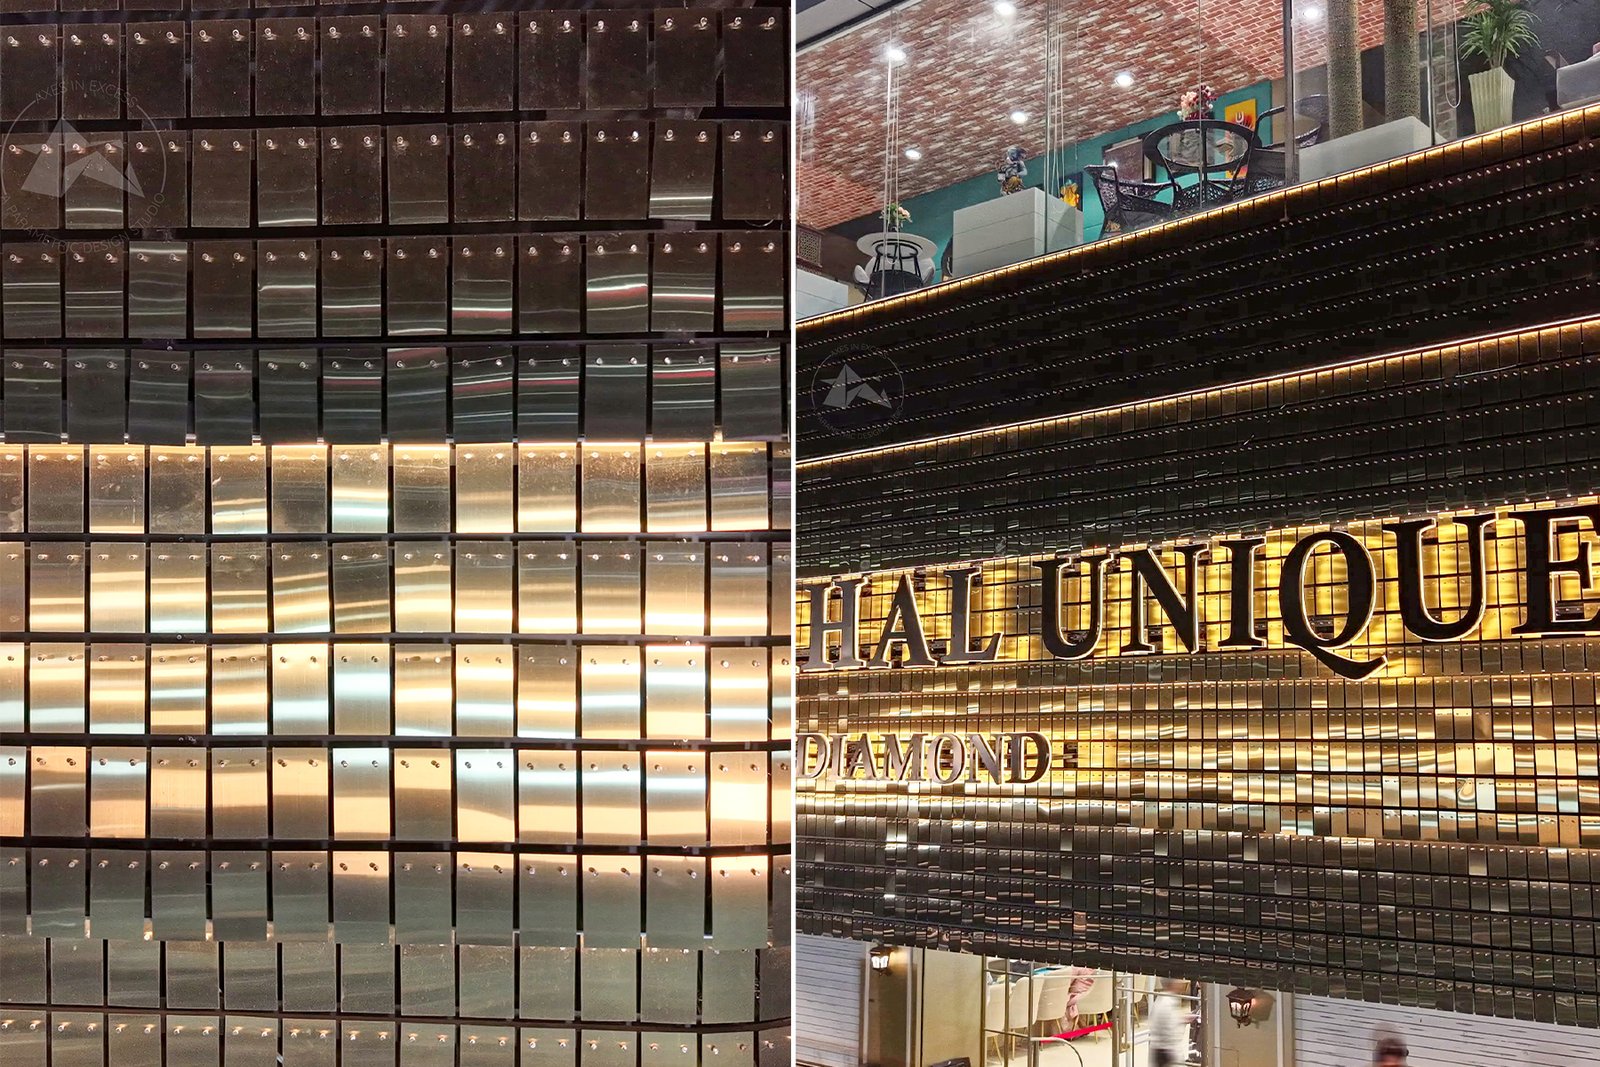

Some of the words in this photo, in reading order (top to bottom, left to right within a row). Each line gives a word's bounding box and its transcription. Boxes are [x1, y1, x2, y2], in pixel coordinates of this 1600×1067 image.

[799, 566, 1005, 672] HAL
[1032, 503, 1600, 681] UNIQUE
[796, 731, 1052, 785] DIAMOND
